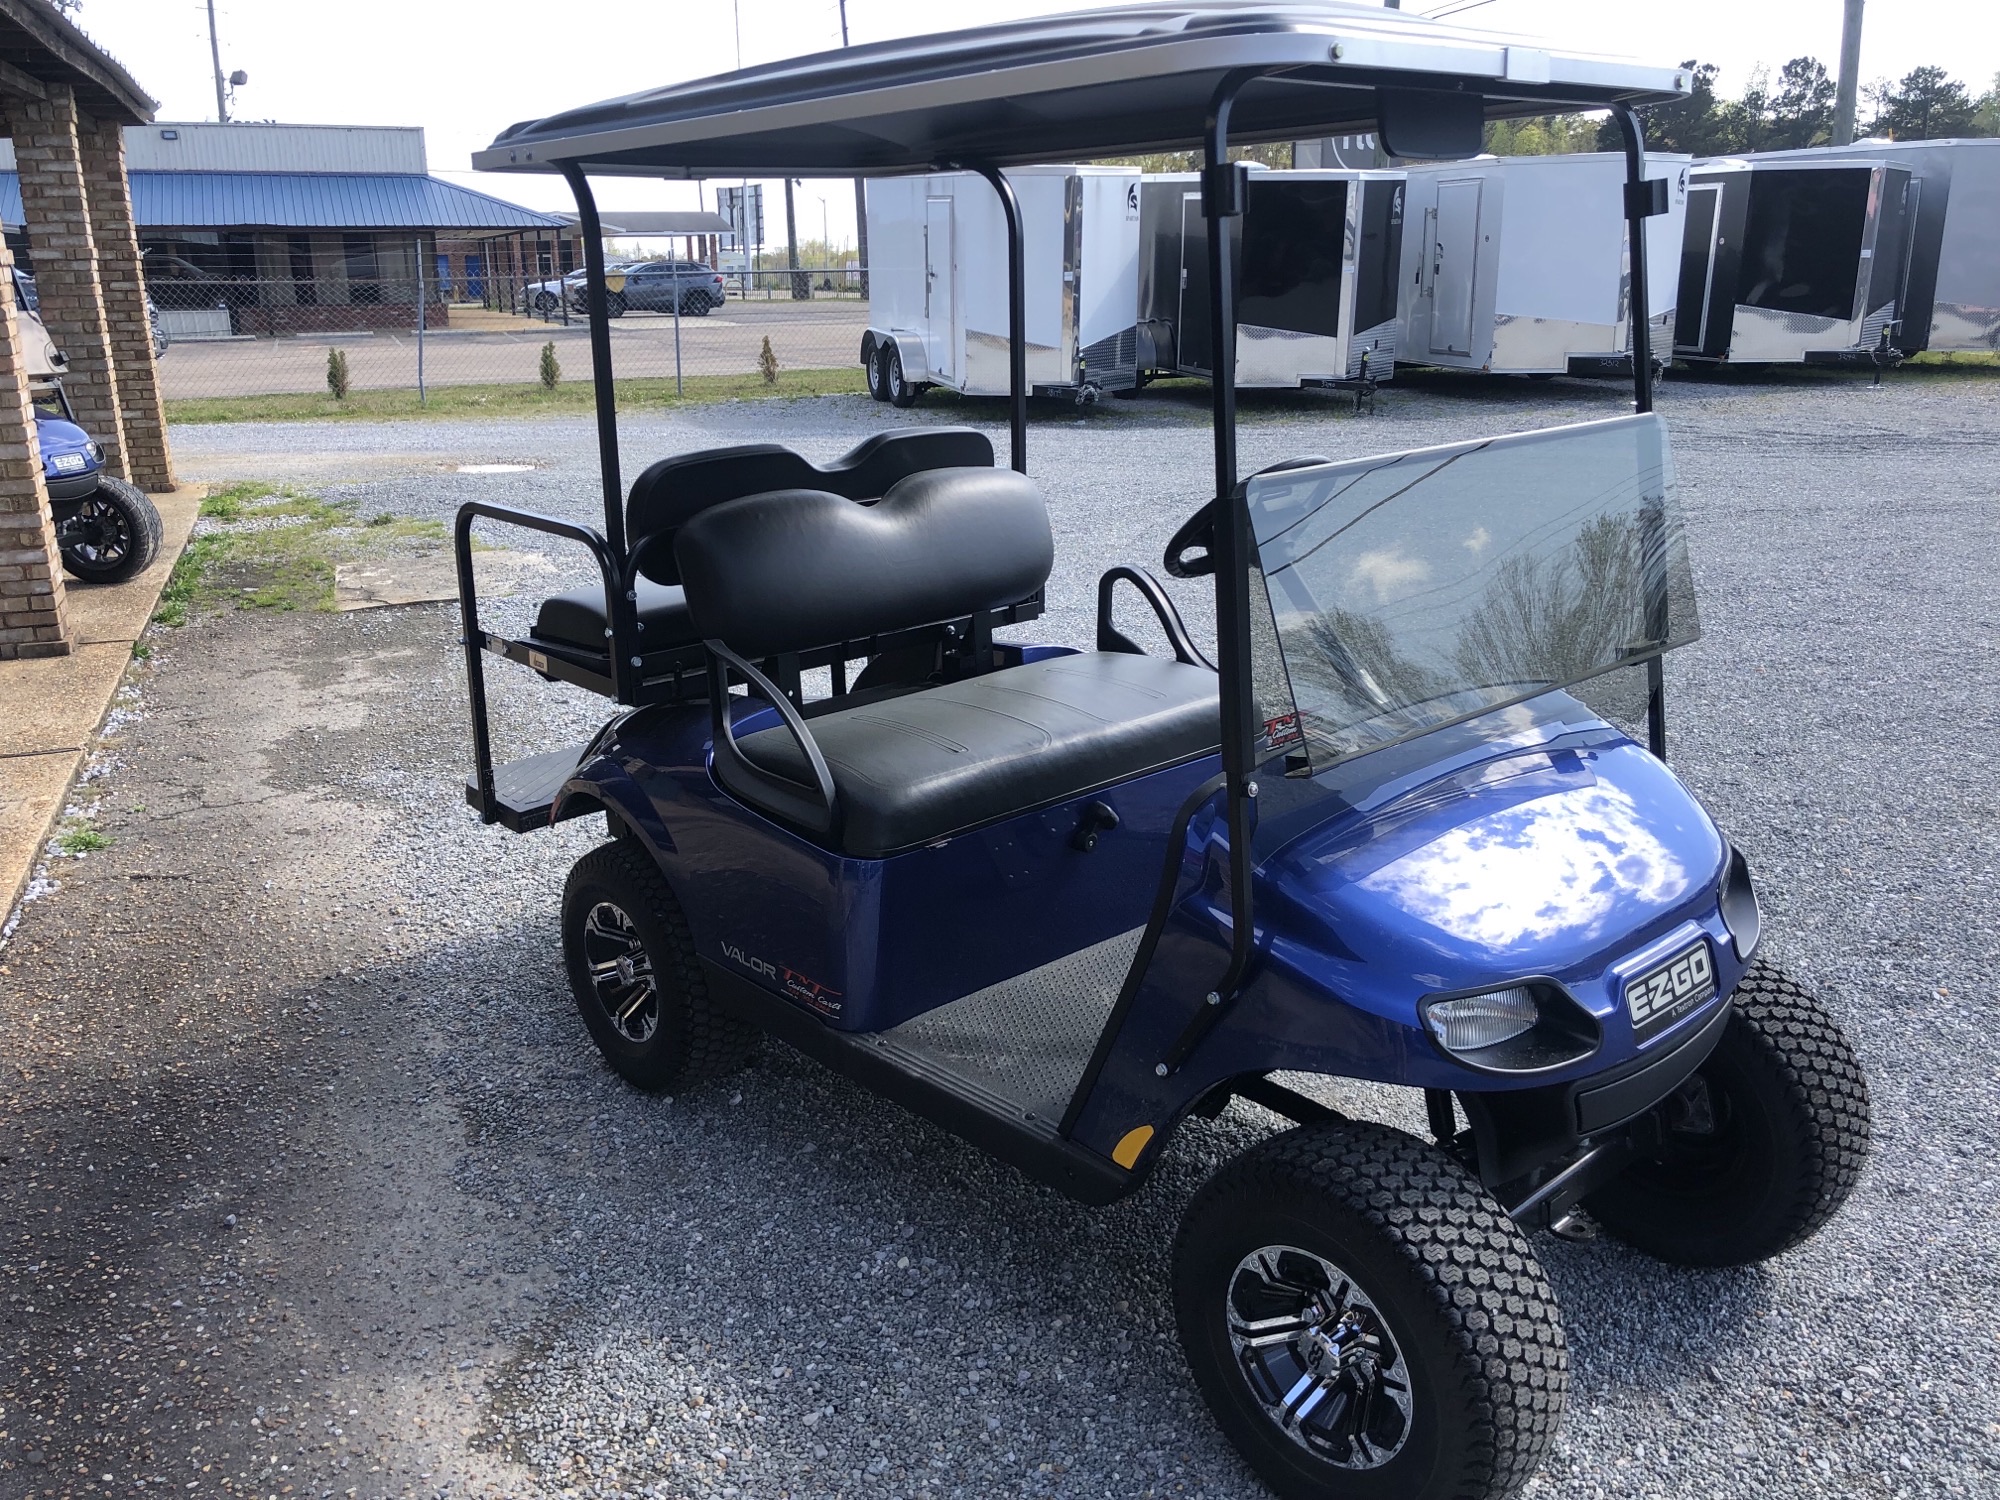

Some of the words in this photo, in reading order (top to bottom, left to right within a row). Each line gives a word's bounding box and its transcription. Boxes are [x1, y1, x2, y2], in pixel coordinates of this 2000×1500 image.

[720, 940, 777, 981] VALOR
[786, 979, 816, 999] Custom
[817, 995, 842, 1011] Carts
[1676, 998, 1695, 1013] Textron
[1694, 984, 1715, 1002] Company
